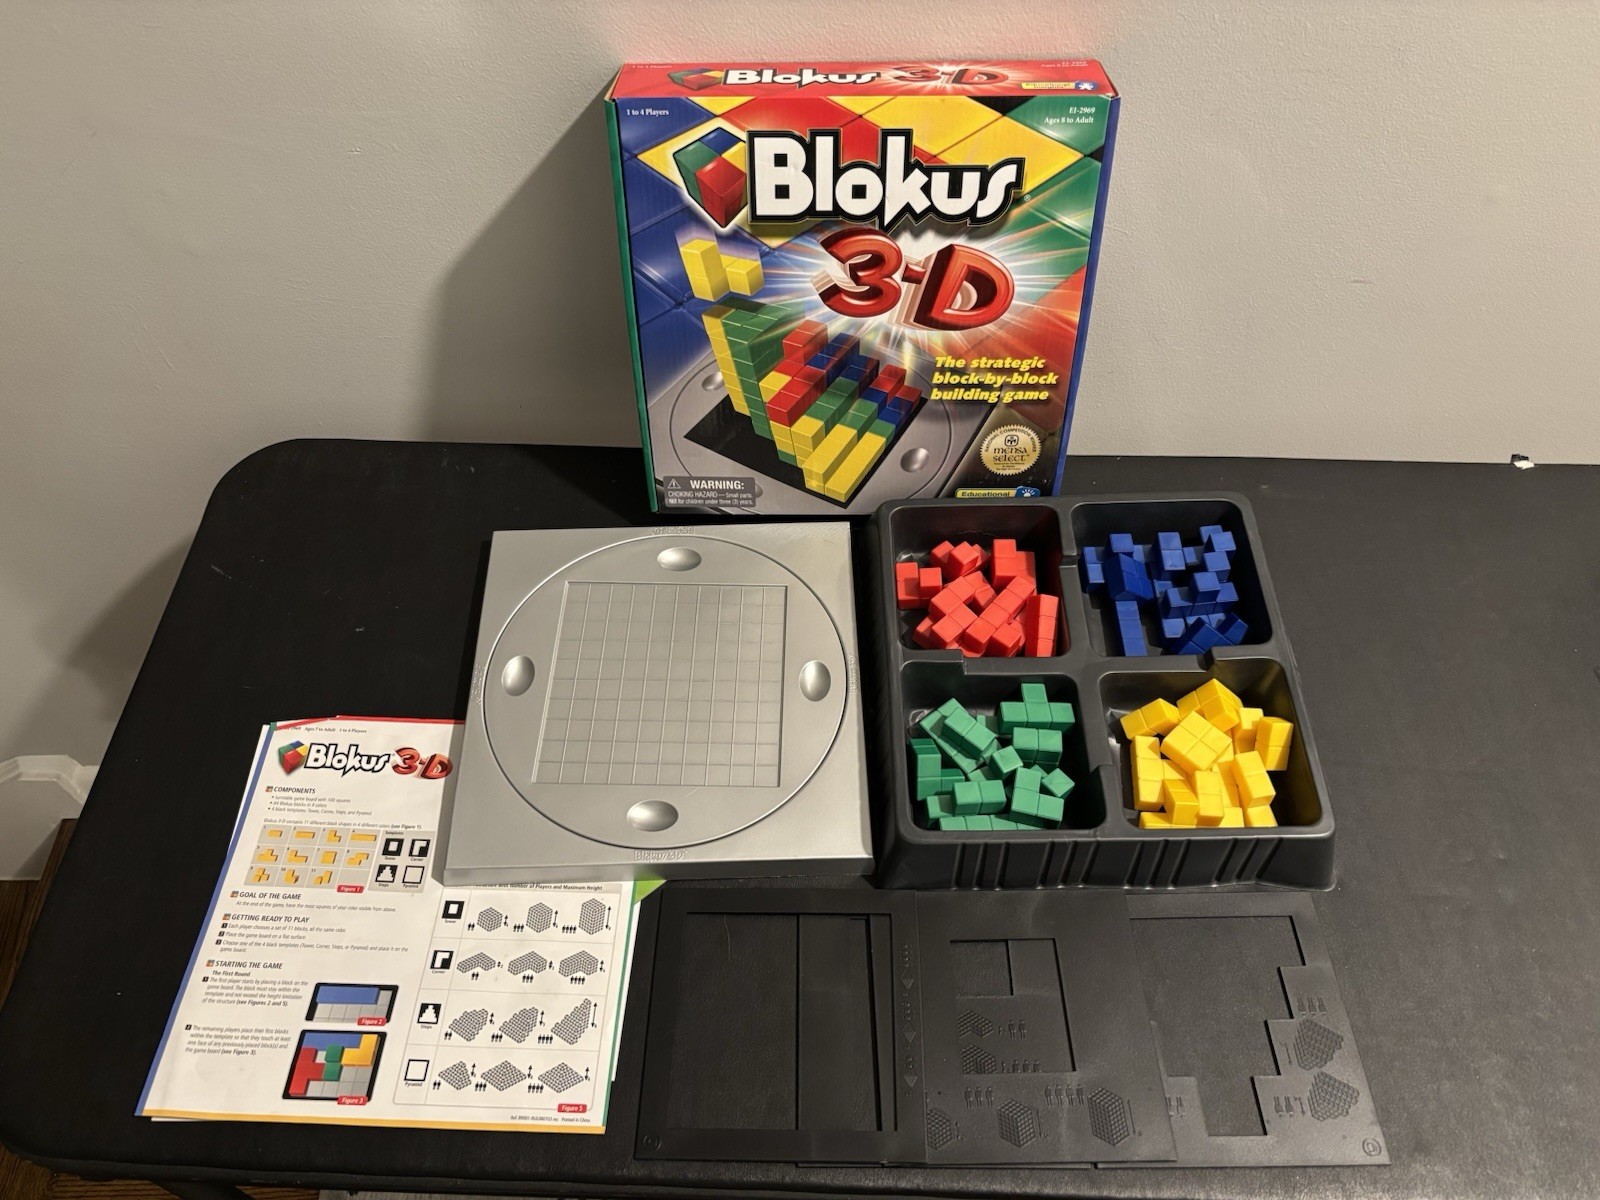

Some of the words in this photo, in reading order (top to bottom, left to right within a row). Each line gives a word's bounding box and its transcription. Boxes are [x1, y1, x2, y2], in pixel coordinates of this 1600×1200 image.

[723, 68, 880, 88] Blokus
[750, 132, 1019, 229] Blokus
[813, 228, 1014, 331] 3-D
[935, 356, 966, 368] The
[971, 356, 1045, 371] strategic
[932, 373, 1059, 387] block-by-block
[931, 388, 999, 403] building
[1002, 390, 1049, 403] game
[993, 454, 1024, 462] select
[690, 480, 744, 489] WARNING:
[304, 742, 391, 777] Blokus
[392, 747, 453, 779] 3-D
[215, 960, 247, 968] STARTING
